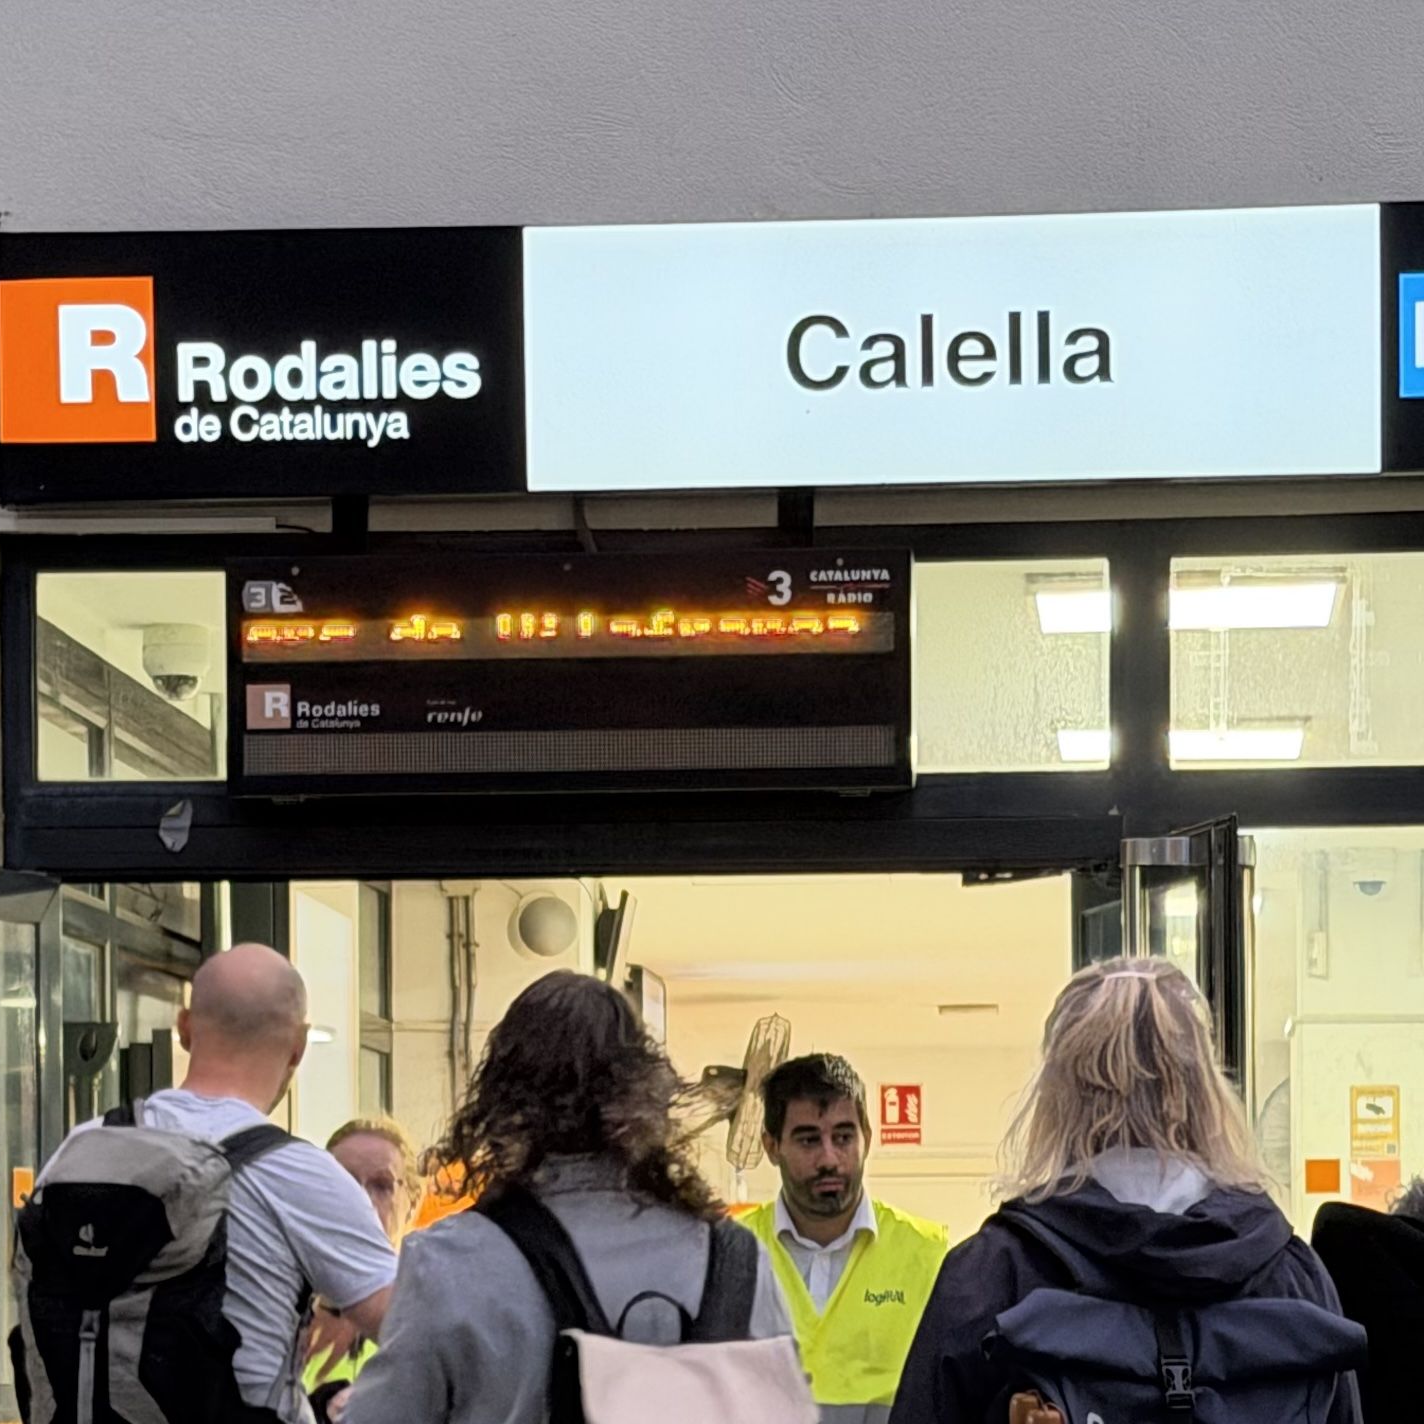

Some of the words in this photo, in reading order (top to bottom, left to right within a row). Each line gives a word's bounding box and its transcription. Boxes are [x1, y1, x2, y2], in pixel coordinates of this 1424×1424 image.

[58, 303, 151, 404] R
[786, 309, 1115, 392] Calella
[176, 339, 483, 403] Rodalies
[175, 407, 222, 443] de
[229, 405, 410, 448] Catalunya
[767, 569, 793, 606] 3
[809, 568, 891, 582] CATALUNYA
[263, 690, 290, 719] R
[296, 700, 381, 717] Rodalies
